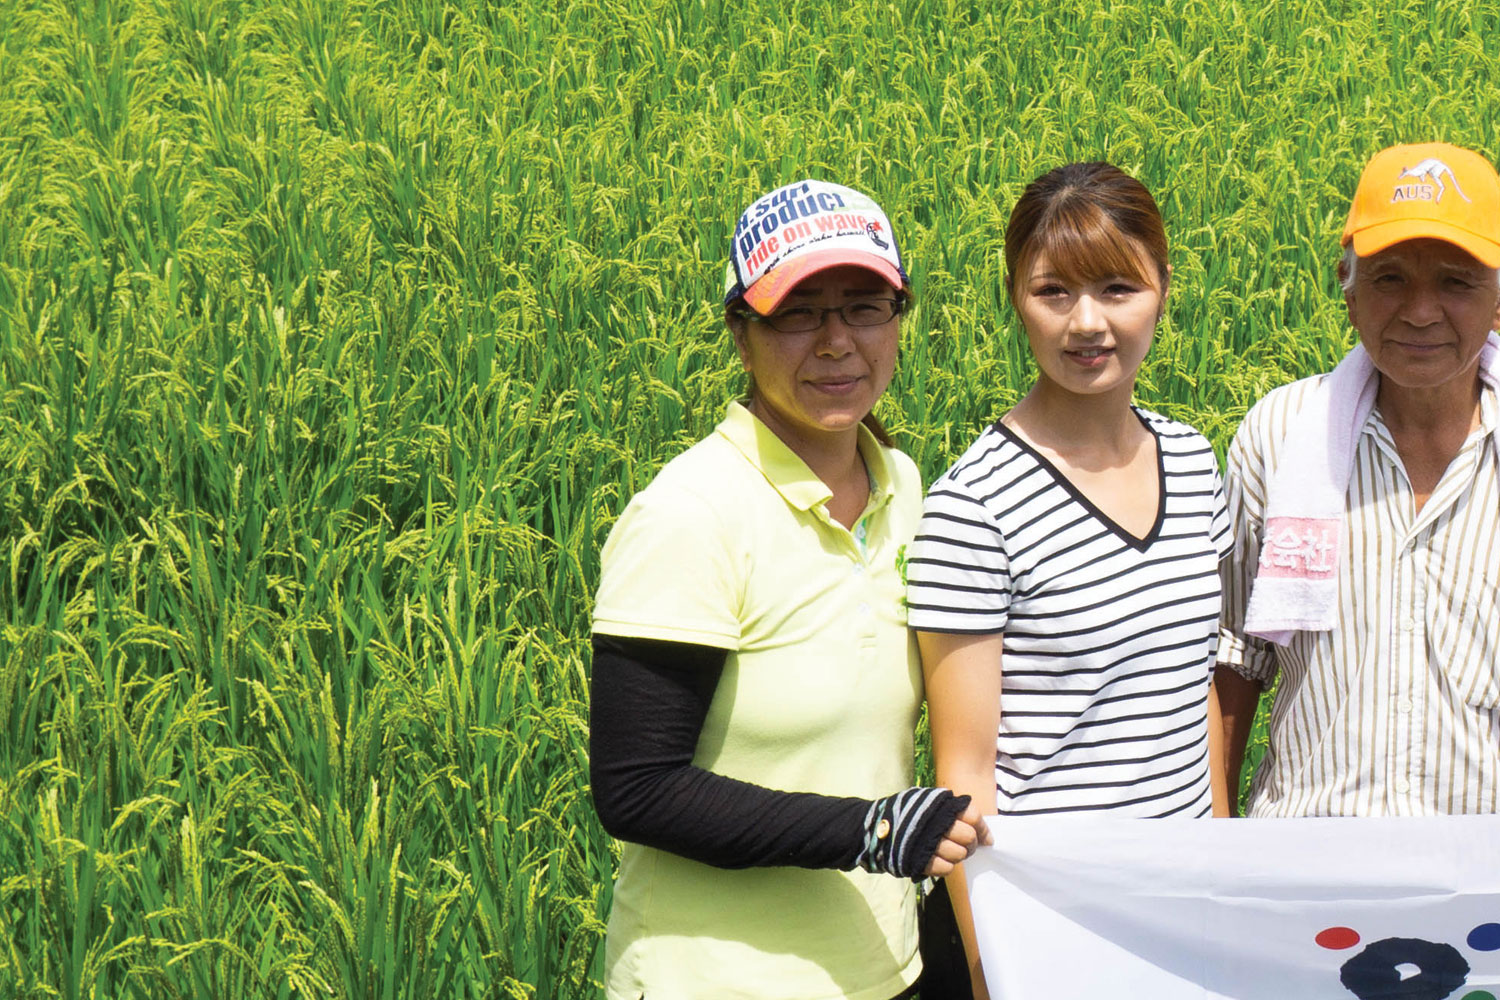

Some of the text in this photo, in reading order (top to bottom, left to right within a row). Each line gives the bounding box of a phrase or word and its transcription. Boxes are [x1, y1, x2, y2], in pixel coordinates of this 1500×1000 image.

[1392, 185, 1433, 201] AUS
[740, 192, 845, 260] product
[746, 236, 780, 276] ride
[783, 222, 812, 244] on
